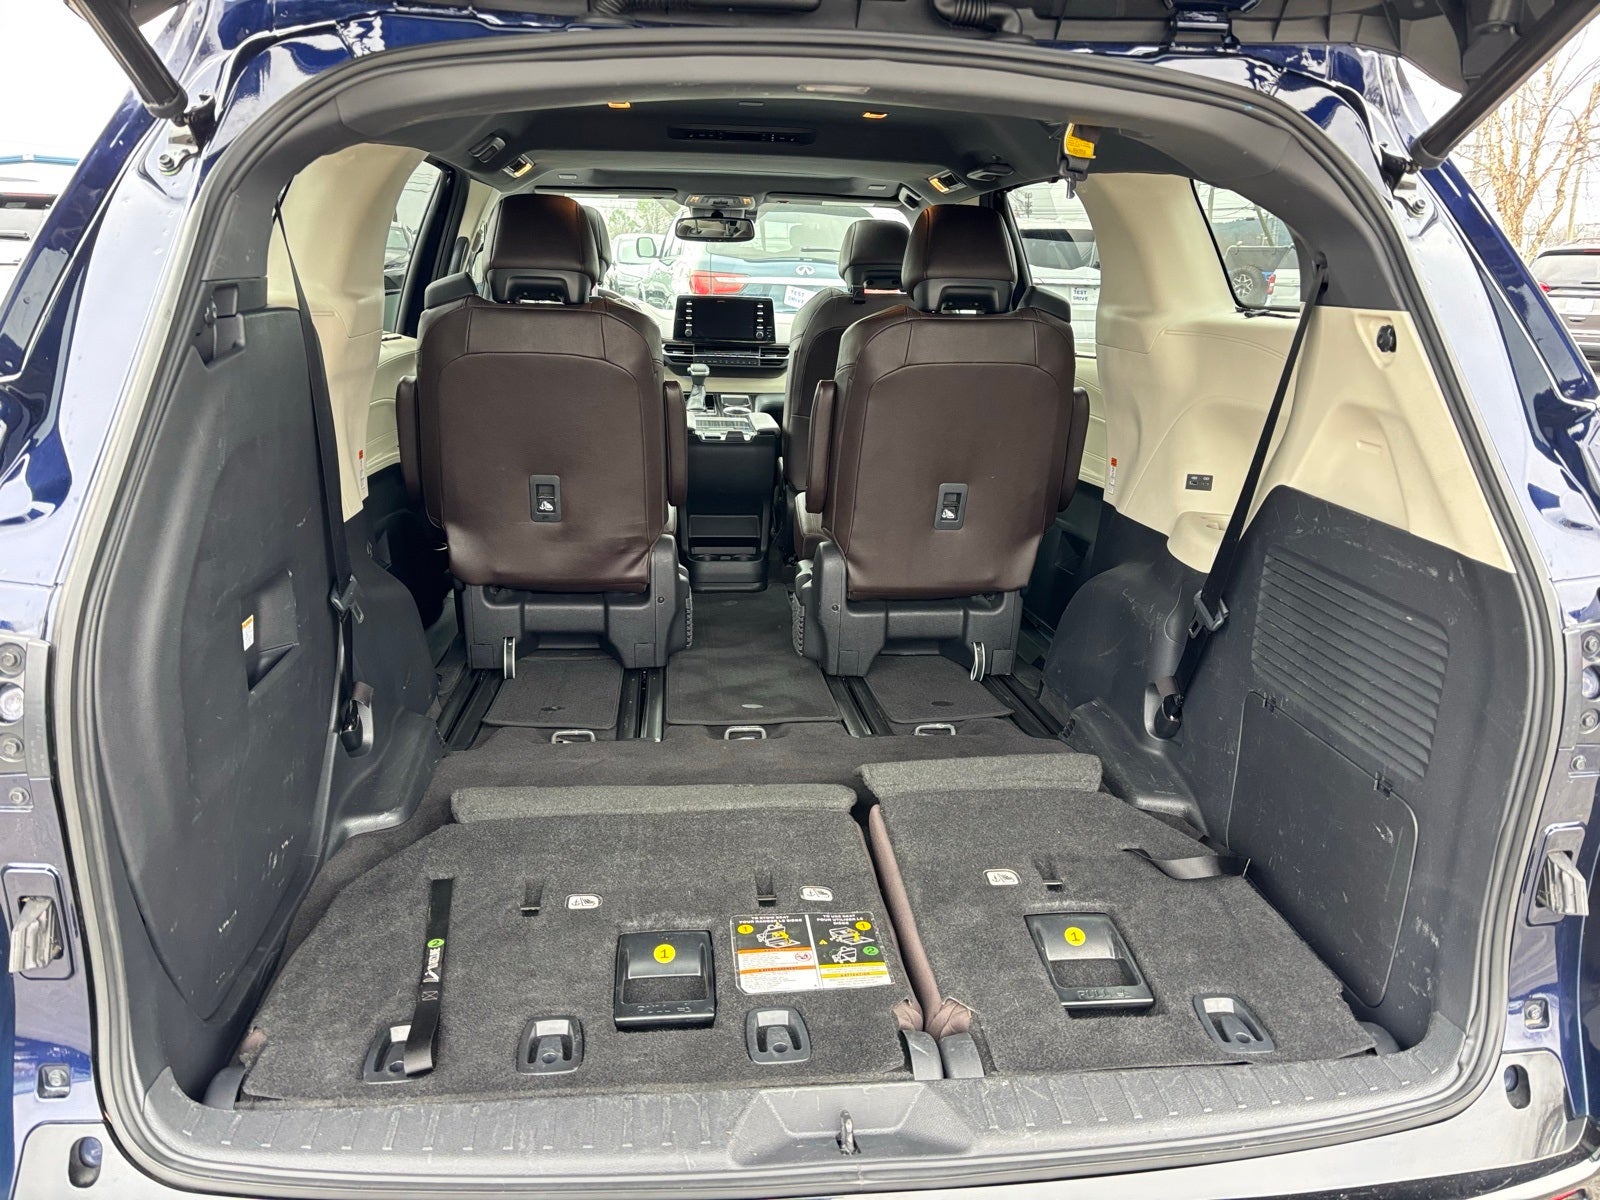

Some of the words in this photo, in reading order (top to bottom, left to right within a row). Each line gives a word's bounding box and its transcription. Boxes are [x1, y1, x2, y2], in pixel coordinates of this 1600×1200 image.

[790, 289, 805, 297] TEST
[1070, 931, 1081, 942] 1
[660, 948, 670, 959] 1
